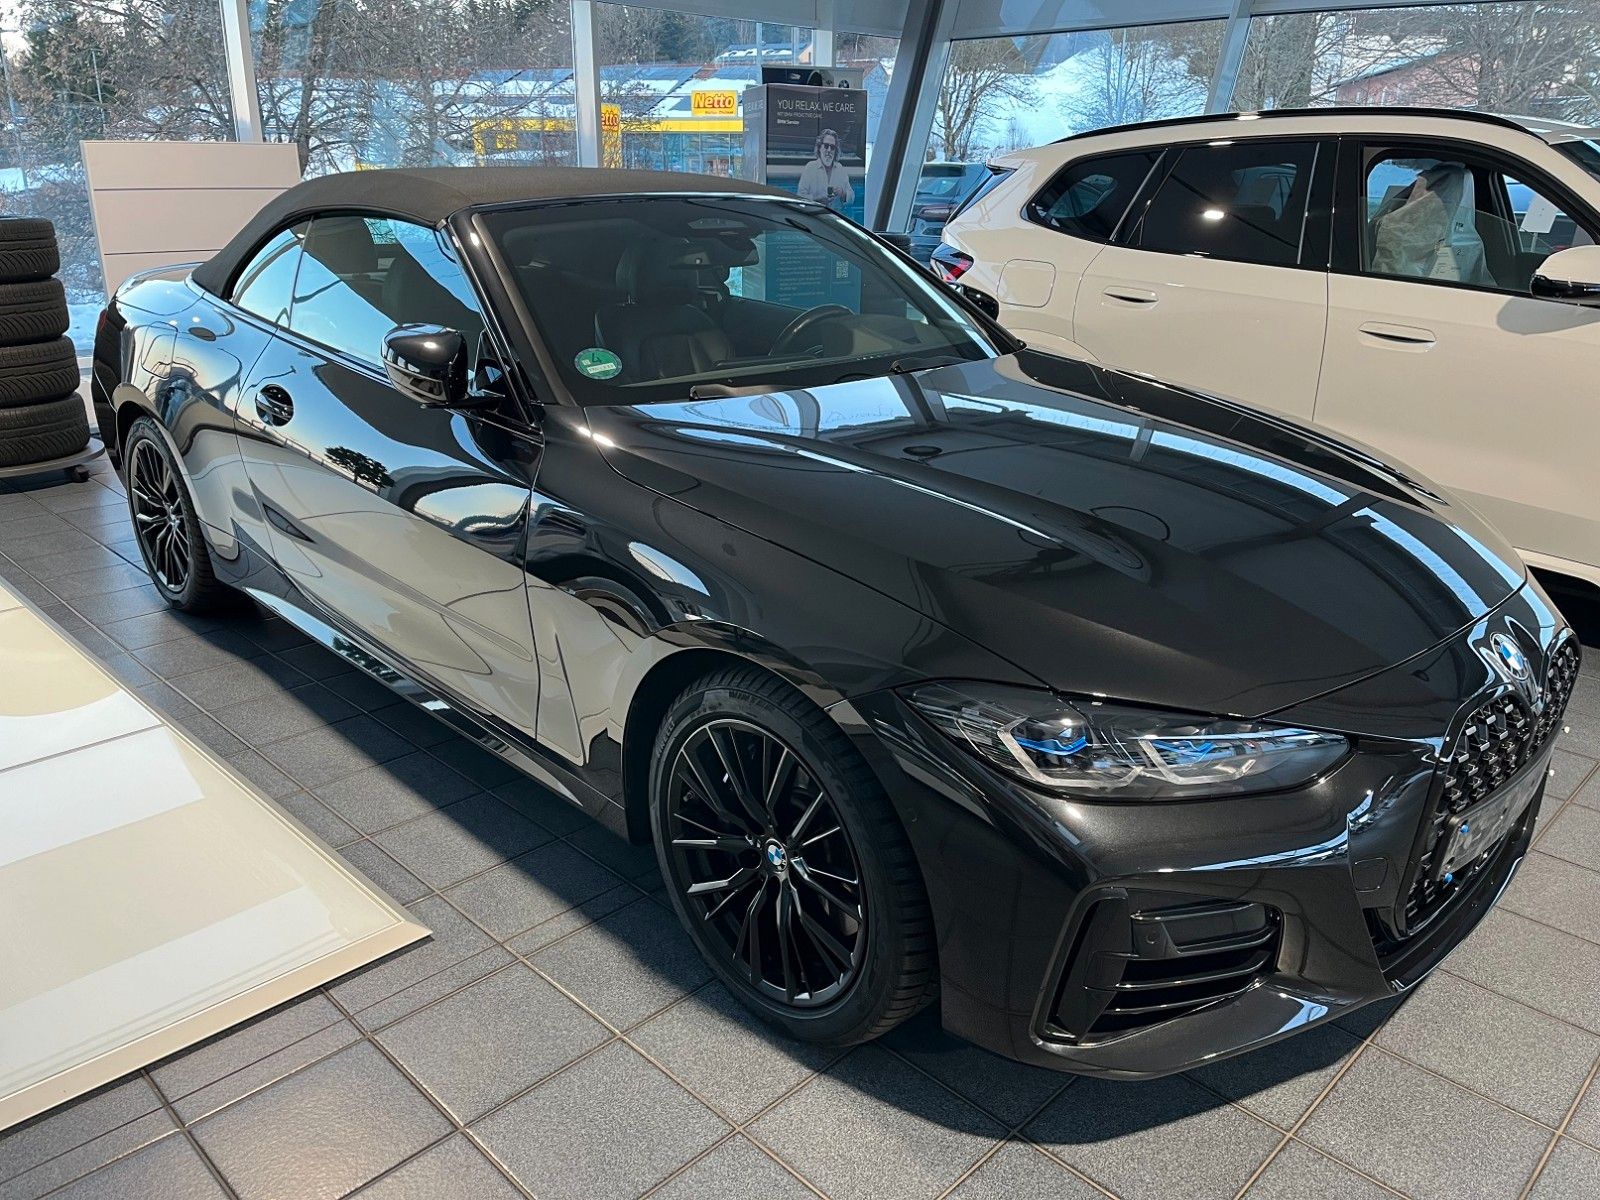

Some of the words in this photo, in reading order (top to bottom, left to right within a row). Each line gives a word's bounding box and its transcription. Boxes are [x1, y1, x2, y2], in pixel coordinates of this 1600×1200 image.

[694, 92, 735, 109] Netto
[777, 99, 794, 110] YOU
[823, 101, 834, 112] WE
[601, 110, 619, 126] etto
